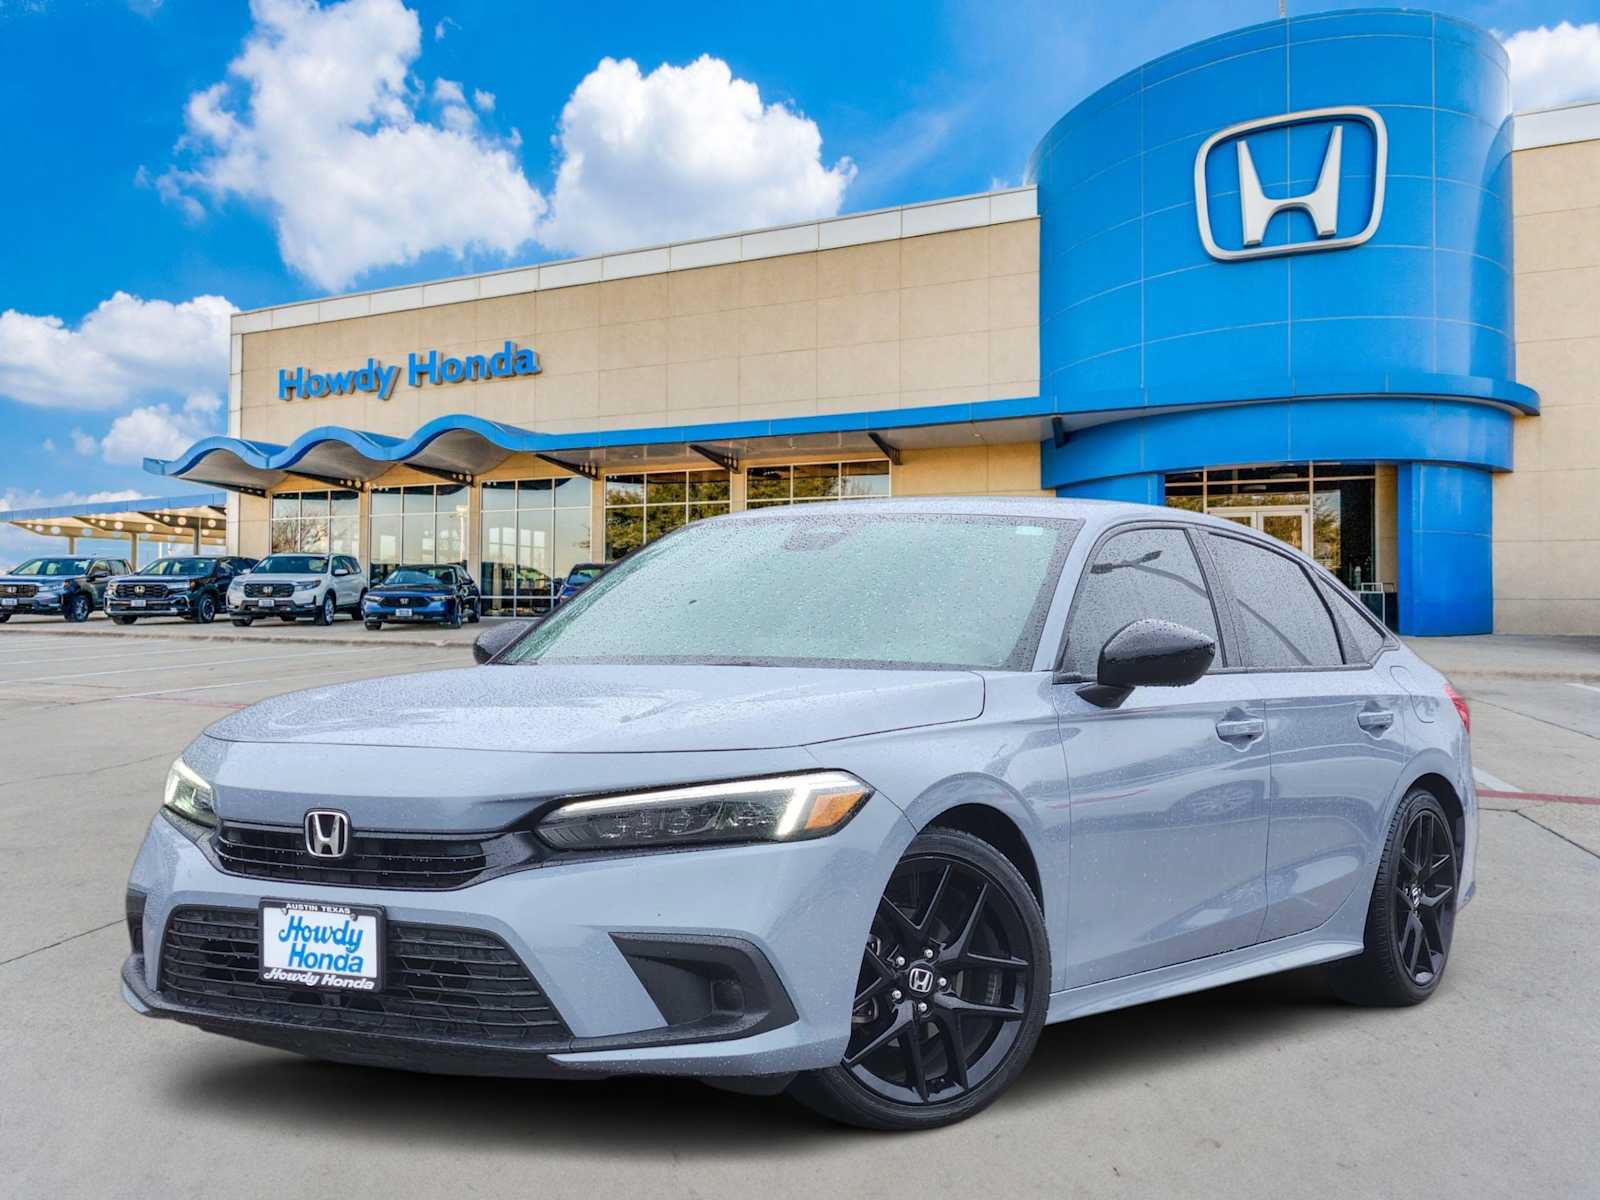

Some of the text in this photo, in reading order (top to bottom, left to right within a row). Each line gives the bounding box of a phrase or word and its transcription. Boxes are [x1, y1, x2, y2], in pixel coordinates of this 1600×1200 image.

[278, 340, 541, 401] Howdy Honda
[285, 903, 351, 914] AUSTIN TEXAS
[278, 915, 364, 953] Howdy
[287, 942, 364, 974] Honda
[263, 967, 376, 990] Howdy Honda
